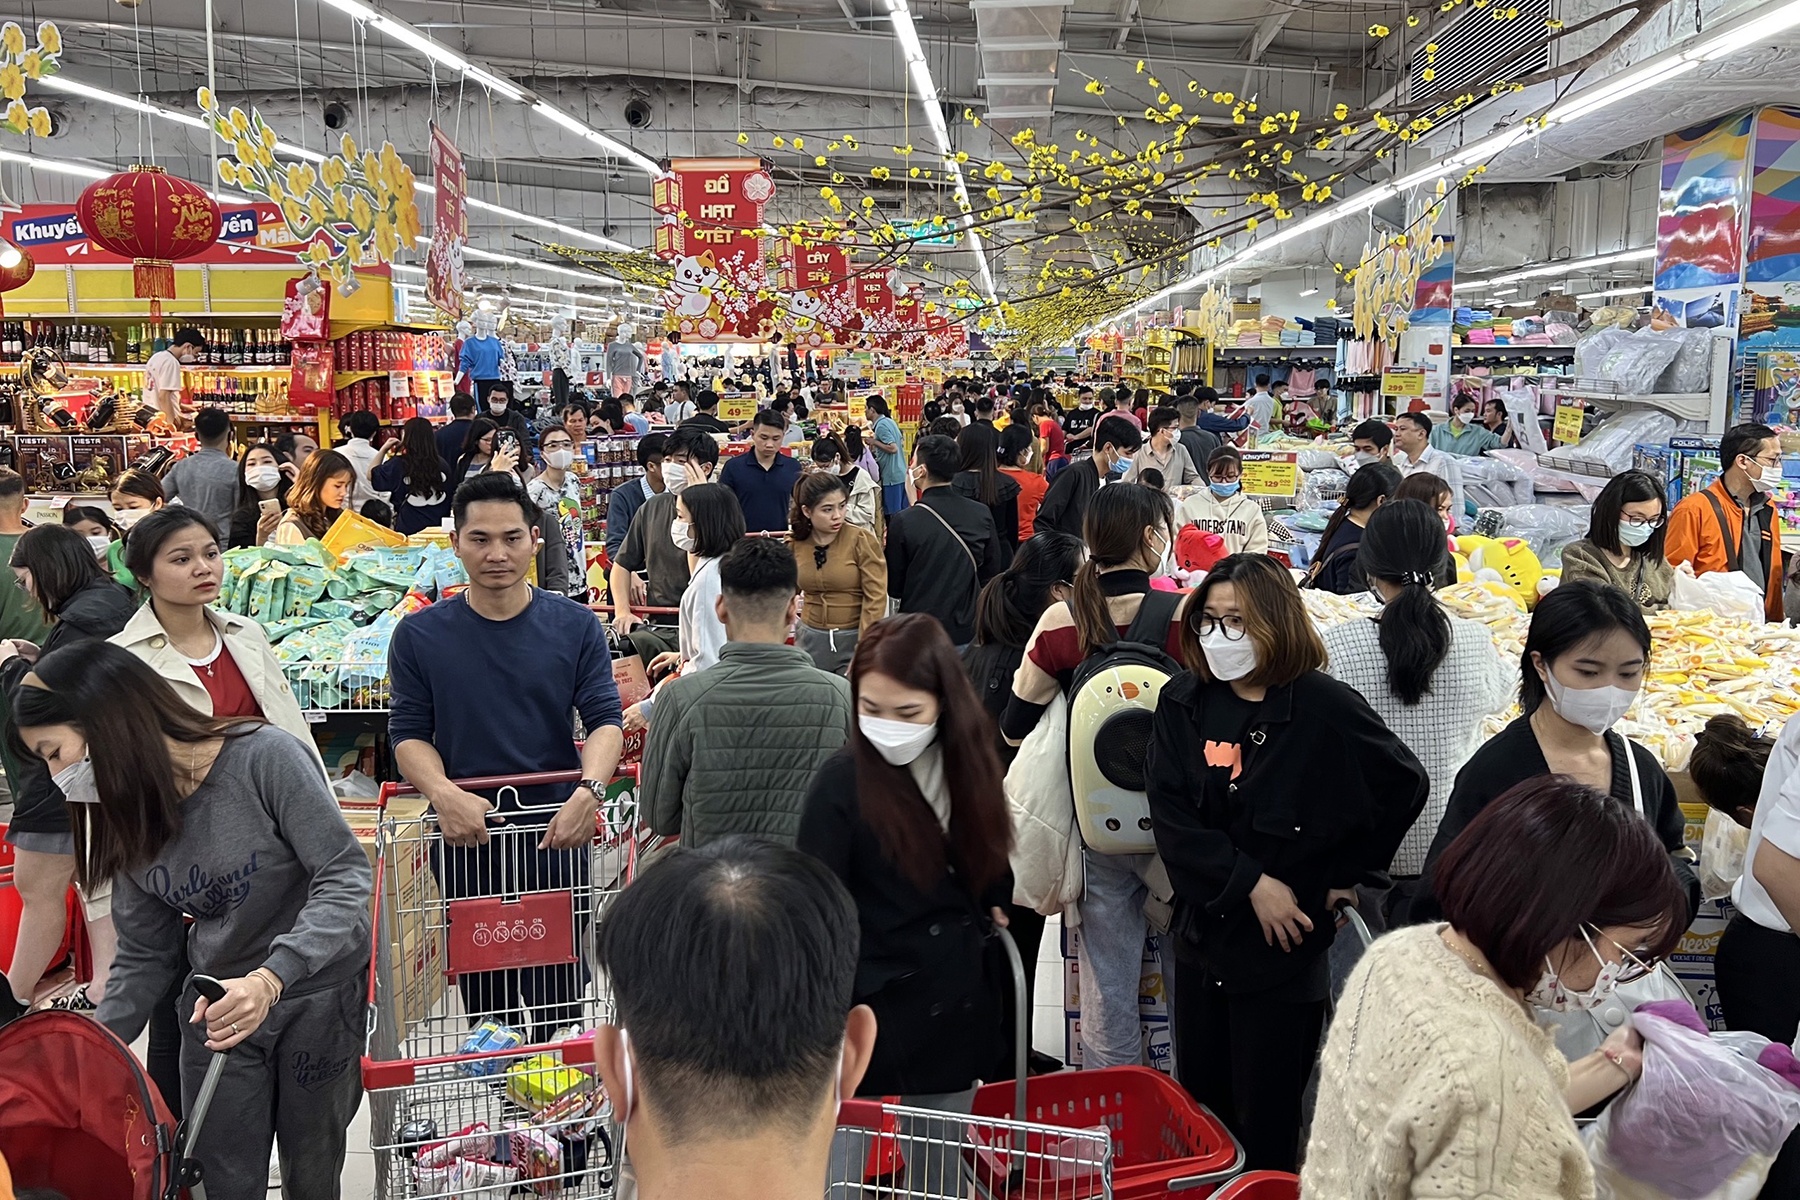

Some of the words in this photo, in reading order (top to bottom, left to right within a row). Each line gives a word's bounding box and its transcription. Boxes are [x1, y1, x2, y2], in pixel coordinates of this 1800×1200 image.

[704, 174, 730, 193] ĐỒ
[700, 204, 735, 221] HẠT
[703, 223, 734, 243] TẾT
[807, 251, 830, 264] CÂY
[864, 294, 880, 303] TẾT
[727, 408, 741, 416] 49
[1242, 452, 1270, 460] Khuyến
[1191, 519, 1246, 536] NDERSTAND
